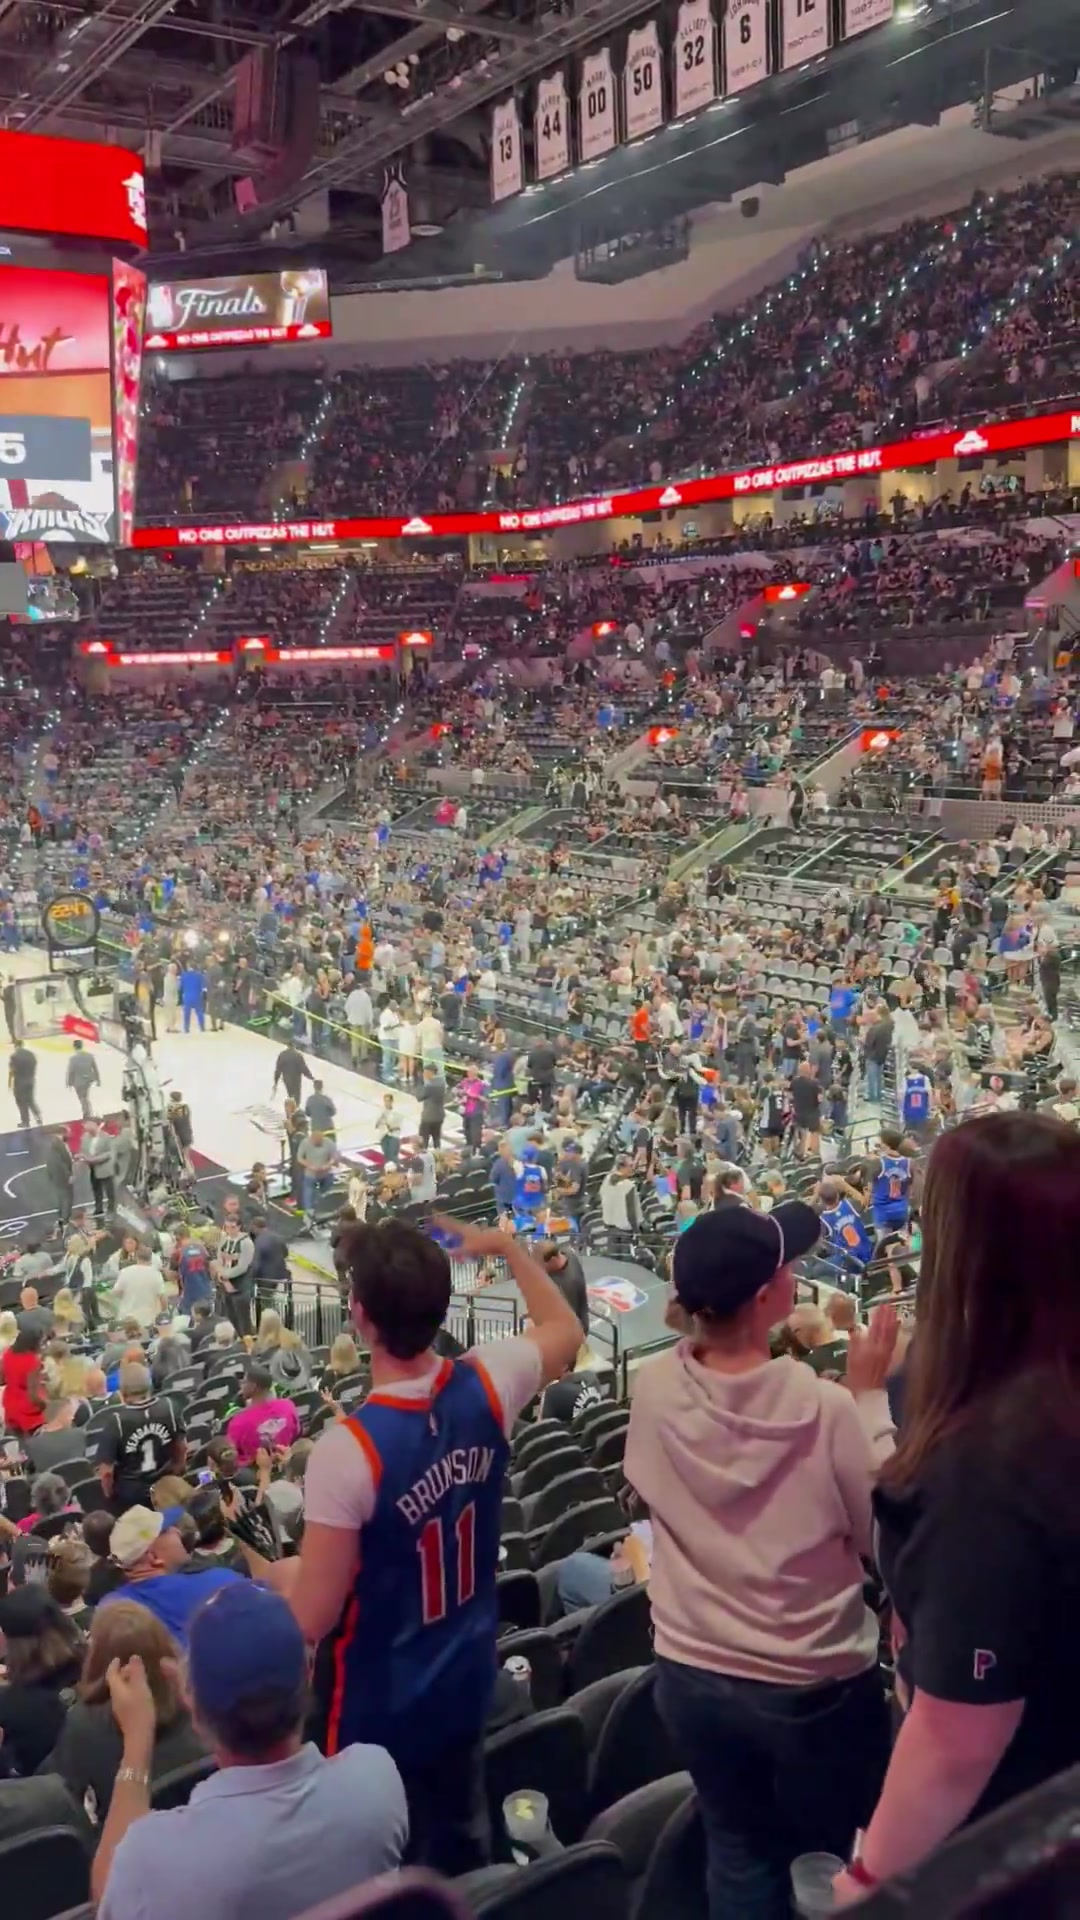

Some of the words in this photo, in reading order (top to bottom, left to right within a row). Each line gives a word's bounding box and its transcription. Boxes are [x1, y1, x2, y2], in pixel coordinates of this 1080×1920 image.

[740, 13, 751, 44] 6
[683, 34, 704, 71] 32
[633, 62, 652, 96] 50
[588, 86, 606, 119] 00
[542, 109, 561, 140] 44
[499, 135, 512, 163] 13
[170, 285, 267, 332] Finals
[0, 432, 26, 464] 5
[734, 474, 751, 491] NO
[752, 469, 774, 488] ONE
[775, 461, 833, 483] OUTPIZZAS
[834, 455, 856, 472] THE
[4, 508, 111, 542] KNICKS
[179, 528, 198, 544] NO
[199, 526, 223, 542] ONE
[224, 524, 287, 541] OUTPIZZAS
[288, 523, 309, 539] THE
[500, 513, 520, 529] NO
[141, 1439, 157, 1472] 1
[395, 1446, 495, 1526] BRUNSON
[415, 1501, 476, 1626] 11
[973, 1648, 998, 1680] P
